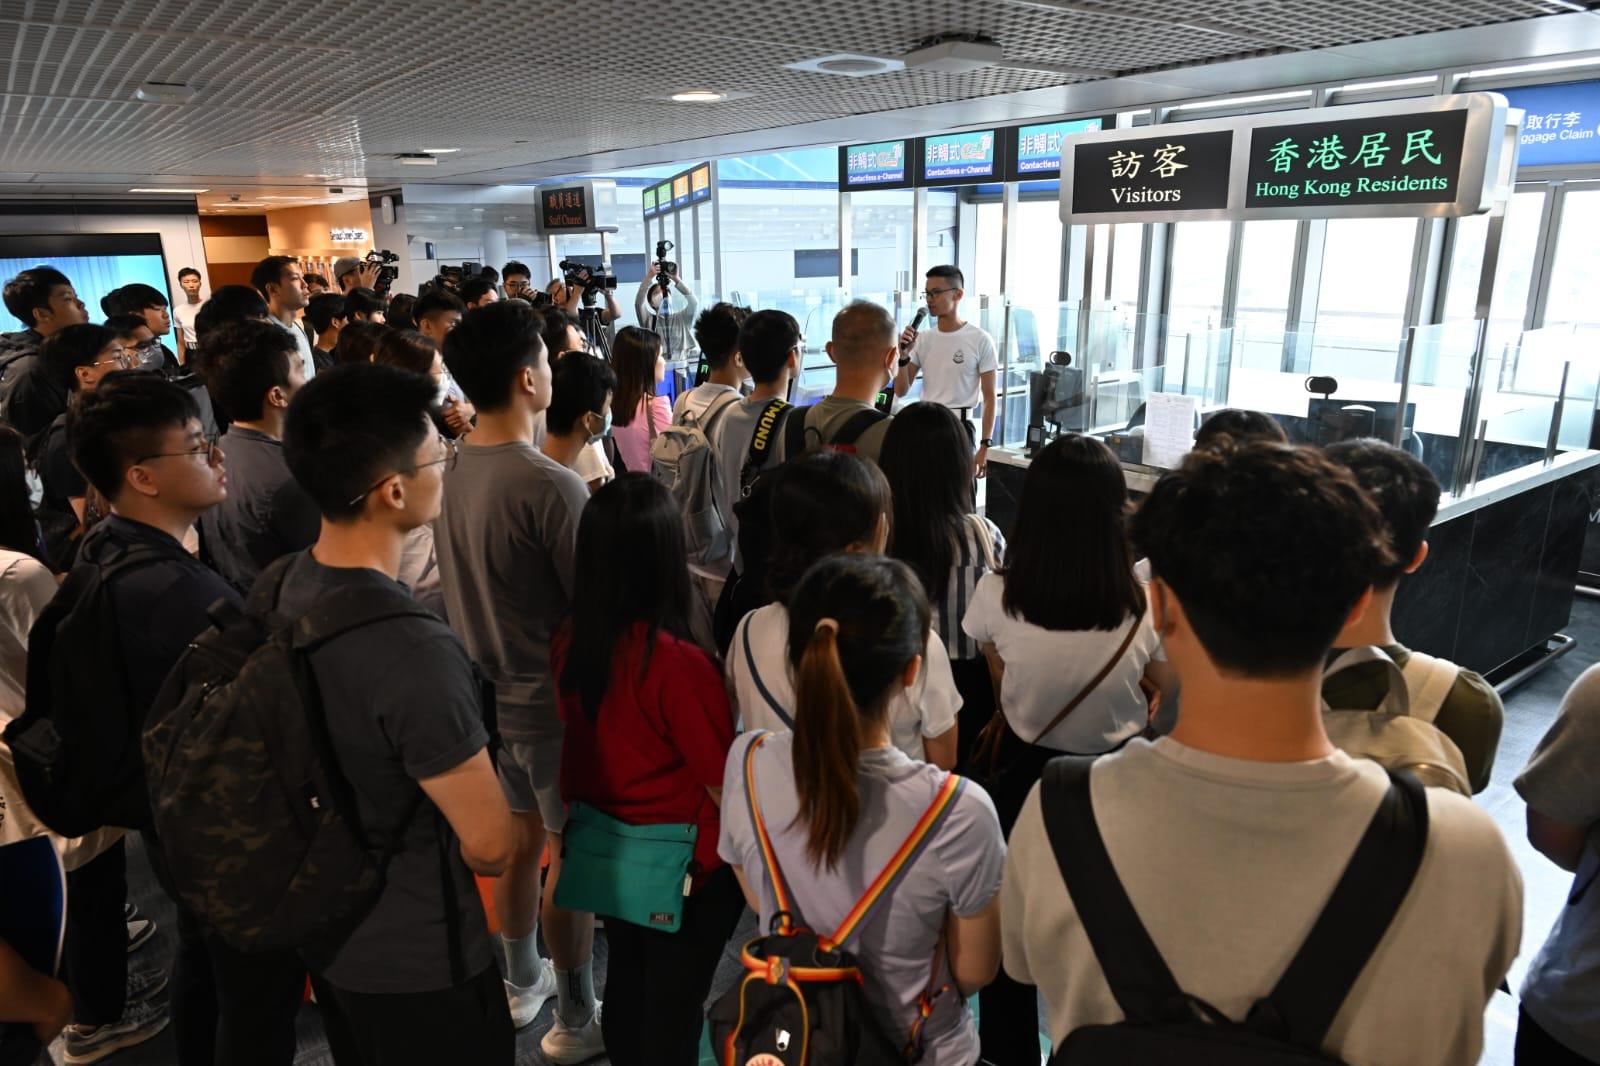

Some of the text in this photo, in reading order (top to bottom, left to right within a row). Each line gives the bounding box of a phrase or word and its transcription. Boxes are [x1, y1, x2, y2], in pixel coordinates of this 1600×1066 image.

[1521, 112, 1581, 130] 取行李
[1520, 128, 1594, 145] ggage Claim
[1266, 128, 1442, 174] 香港居民
[1020, 160, 1060, 170] Contactless
[1108, 143, 1189, 179] 訪客
[848, 174, 877, 183] Contactless
[927, 164, 992, 177] Contactless e-Channel
[1110, 186, 1181, 204] Visitors
[1255, 175, 1448, 199] Hong Kong Residents
